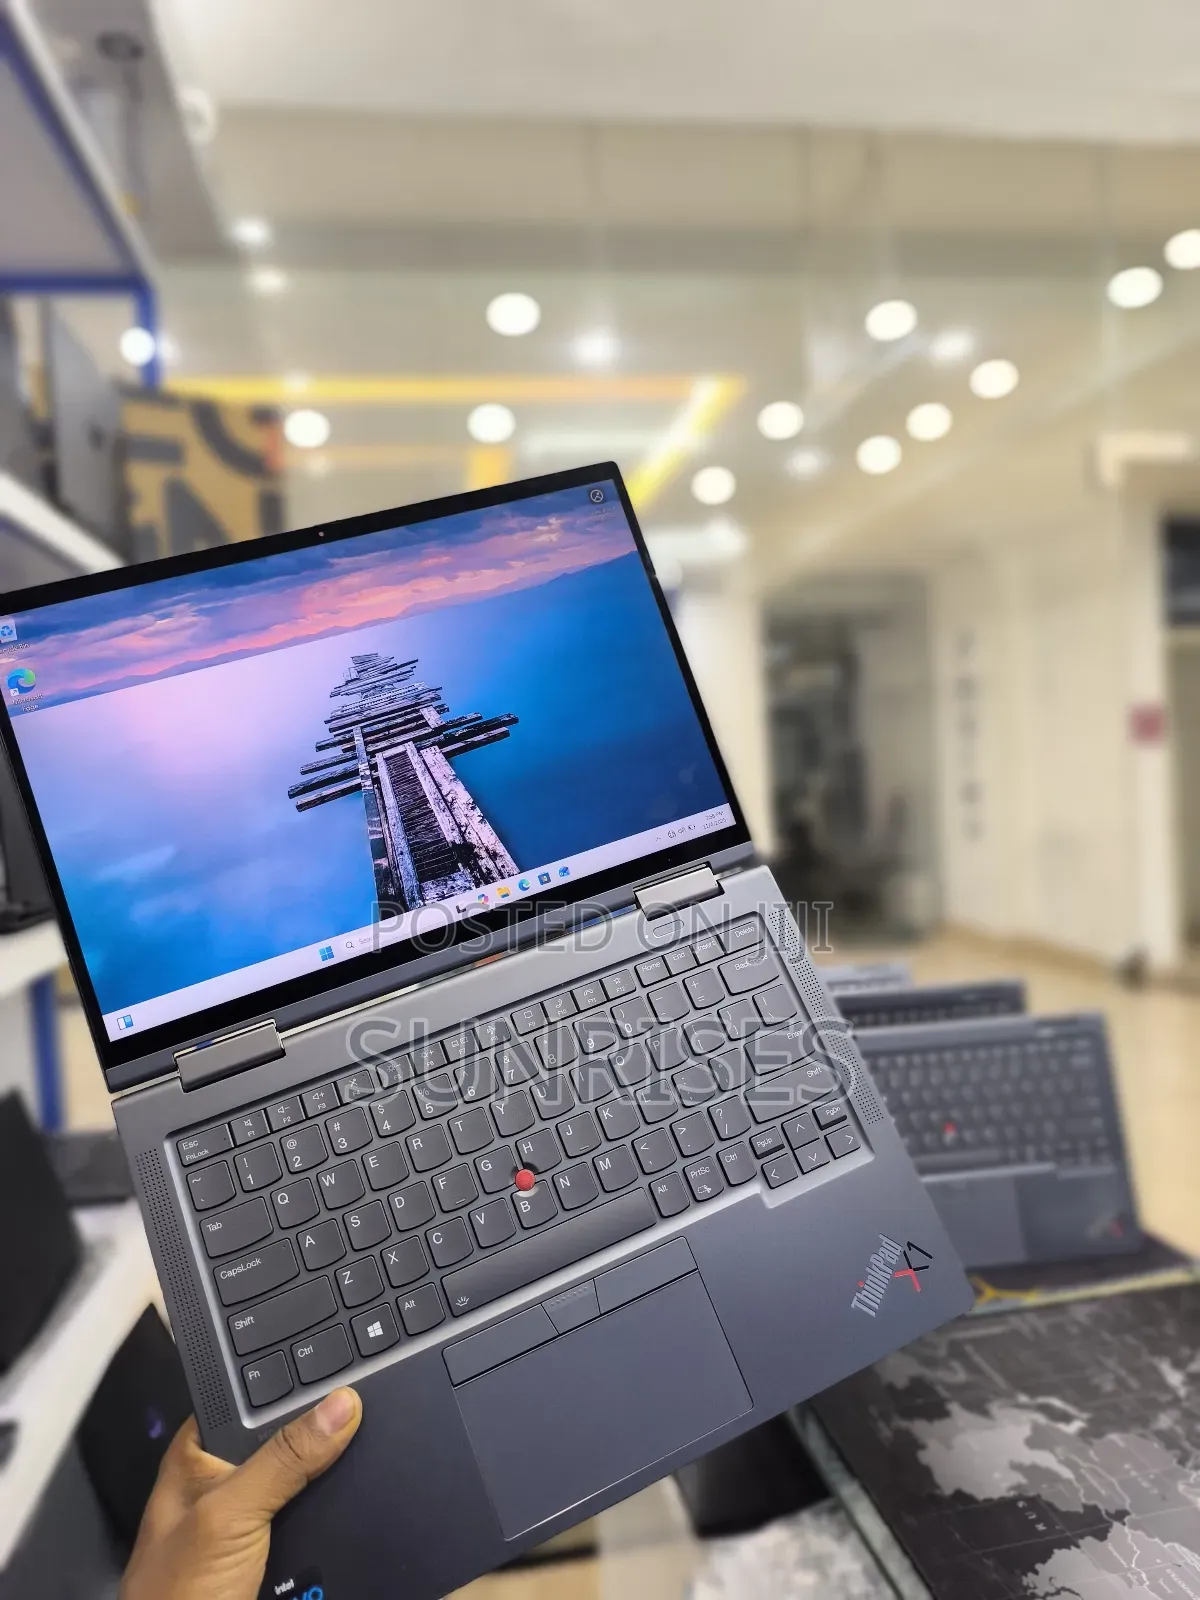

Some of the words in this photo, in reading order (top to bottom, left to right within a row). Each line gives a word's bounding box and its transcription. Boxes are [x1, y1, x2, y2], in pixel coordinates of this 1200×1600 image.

[735, 926, 754, 938] Delete
[642, 960, 660, 972] Home
[624, 1023, 632, 1034] 0
[586, 1038, 594, 1048] 9
[652, 1040, 660, 1050] P
[548, 1054, 556, 1064] 8
[616, 1056, 625, 1066] O
[507, 1069, 515, 1080] 7
[806, 1066, 822, 1078] Shift
[468, 1086, 476, 1096] 6
[537, 1086, 546, 1098] U
[318, 1102, 326, 1110] F3
[378, 1104, 385, 1114] $
[426, 1102, 434, 1114] 5
[496, 1104, 506, 1115] Y
[826, 1105, 840, 1116] PgDn
[602, 1108, 614, 1120] K
[715, 1108, 723, 1119] ?
[282, 1116, 292, 1124] F2
[382, 1120, 391, 1130] 4
[454, 1120, 463, 1132] T
[334, 1122, 341, 1132] #
[566, 1124, 573, 1136] J
[248, 1130, 256, 1138] F1
[182, 1140, 198, 1150] Esc
[286, 1139, 297, 1150] @
[338, 1138, 348, 1148] 3
[412, 1138, 423, 1150] R
[522, 1142, 534, 1154] H
[756, 1136, 772, 1148] PgUp
[185, 1149, 210, 1161] FnLock
[725, 1152, 738, 1163] Ctrl
[292, 1156, 302, 1168] 2
[368, 1156, 380, 1168] E
[481, 1160, 492, 1171] G
[598, 1158, 612, 1170] M
[690, 1166, 710, 1179] PrtSc
[247, 1174, 254, 1184] 1
[322, 1173, 335, 1187] W
[438, 1176, 446, 1190] F
[559, 1176, 571, 1188] N
[658, 1184, 668, 1194] Alt
[277, 1193, 289, 1205] Q
[395, 1197, 405, 1208] D
[520, 1200, 531, 1213] B
[350, 1216, 360, 1227] S
[476, 1212, 485, 1225] V
[206, 1222, 222, 1232] Tab
[305, 1235, 316, 1248] A
[432, 1232, 443, 1244] C
[388, 1251, 399, 1264] X
[220, 1257, 262, 1280] CapsLock
[342, 1271, 353, 1285] Z
[850, 1232, 902, 1318] ThinkPad
[893, 1241, 933, 1292] X1
[404, 1299, 416, 1310] Alt
[235, 1316, 255, 1330] Shift
[298, 1345, 314, 1358] Ctrl
[248, 1370, 260, 1380] Fn
